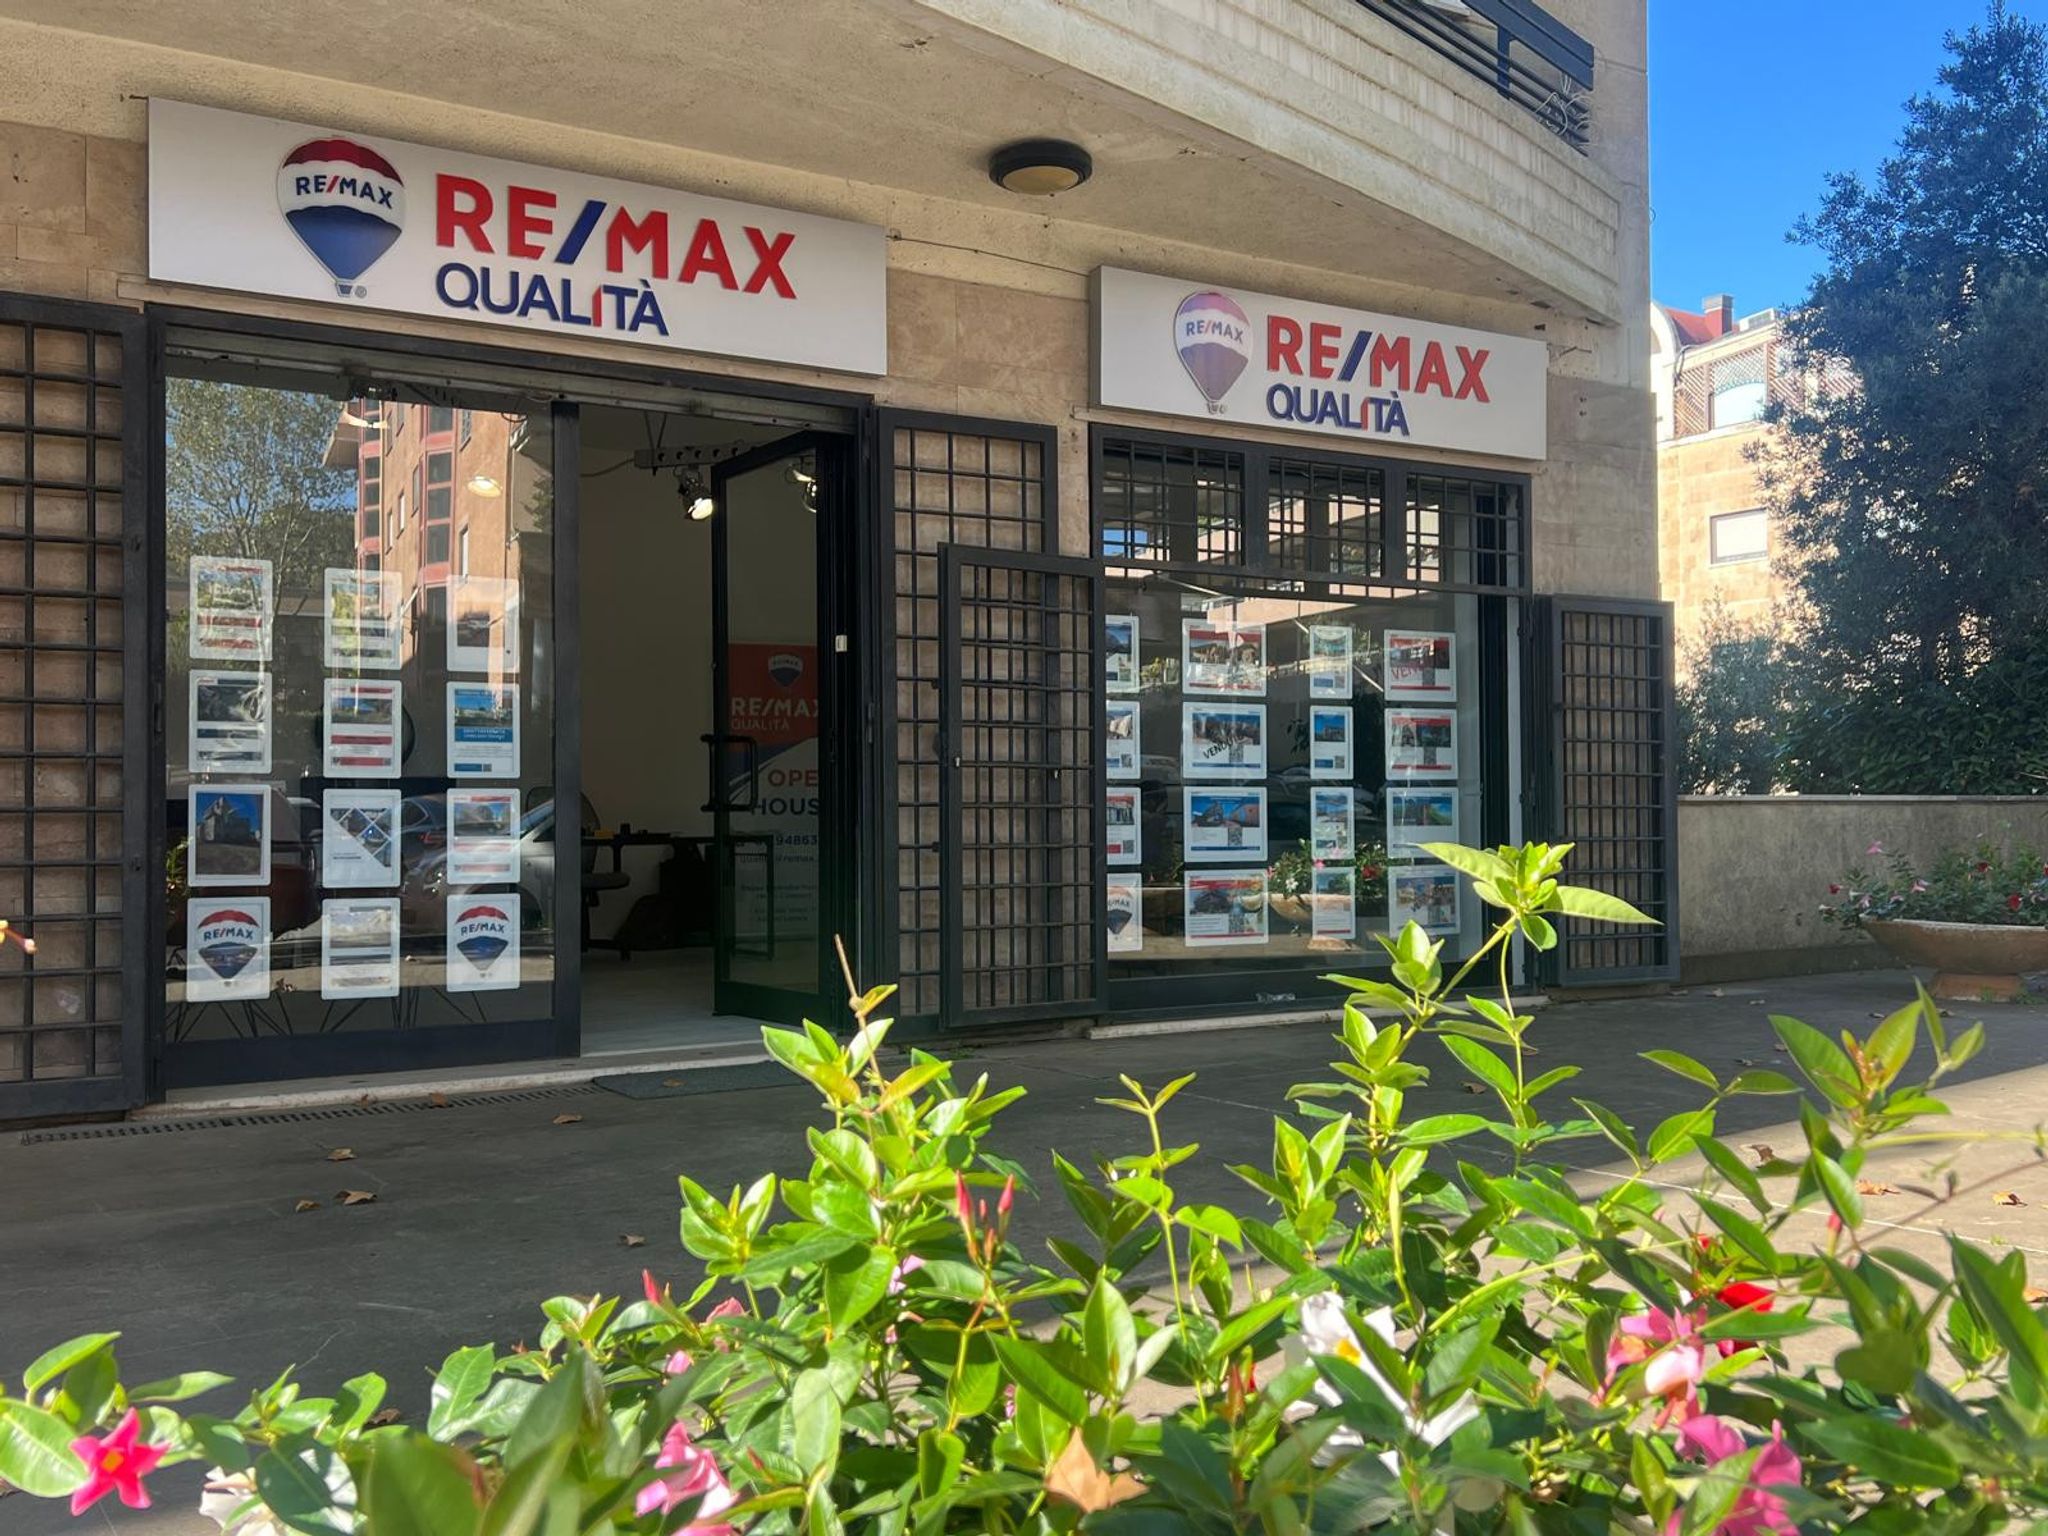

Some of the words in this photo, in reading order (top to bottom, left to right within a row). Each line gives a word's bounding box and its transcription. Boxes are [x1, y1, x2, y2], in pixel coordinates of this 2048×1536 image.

[295, 173, 394, 210] RE/MAX
[435, 173, 797, 299] RE/MAX
[435, 262, 669, 336] QUALITÀ
[1186, 319, 1243, 345] RE/MAX
[1267, 315, 1490, 403] RE/MAX
[1266, 383, 1410, 436] QUALITÀ
[767, 769, 818, 787] OPE
[752, 797, 819, 815] HOUS
[203, 927, 254, 942] RE/MAX
[461, 922, 505, 936] RE/MAX
